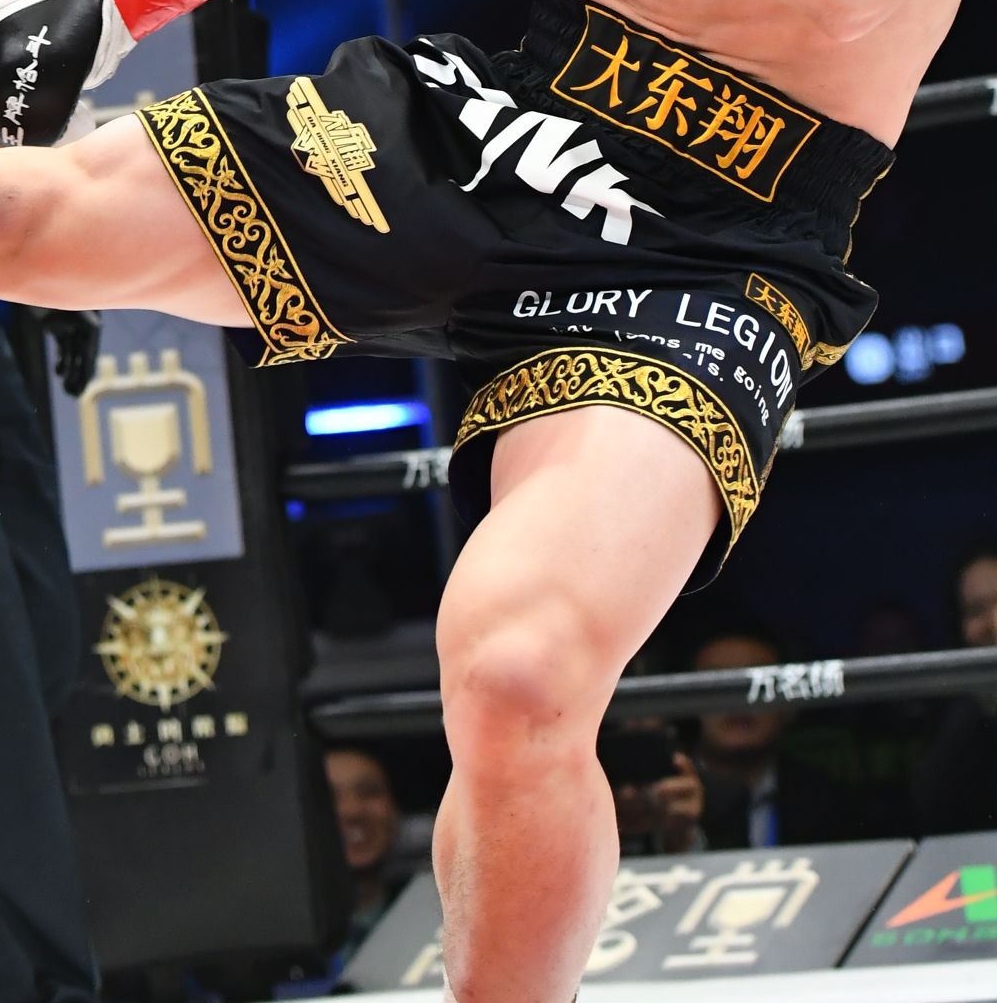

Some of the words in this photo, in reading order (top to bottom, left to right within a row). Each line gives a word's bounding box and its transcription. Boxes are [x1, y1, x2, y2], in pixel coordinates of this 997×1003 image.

[570, 35, 786, 180] 大东翔
[512, 288, 653, 319] GLORY
[675, 292, 793, 410] LEGION
